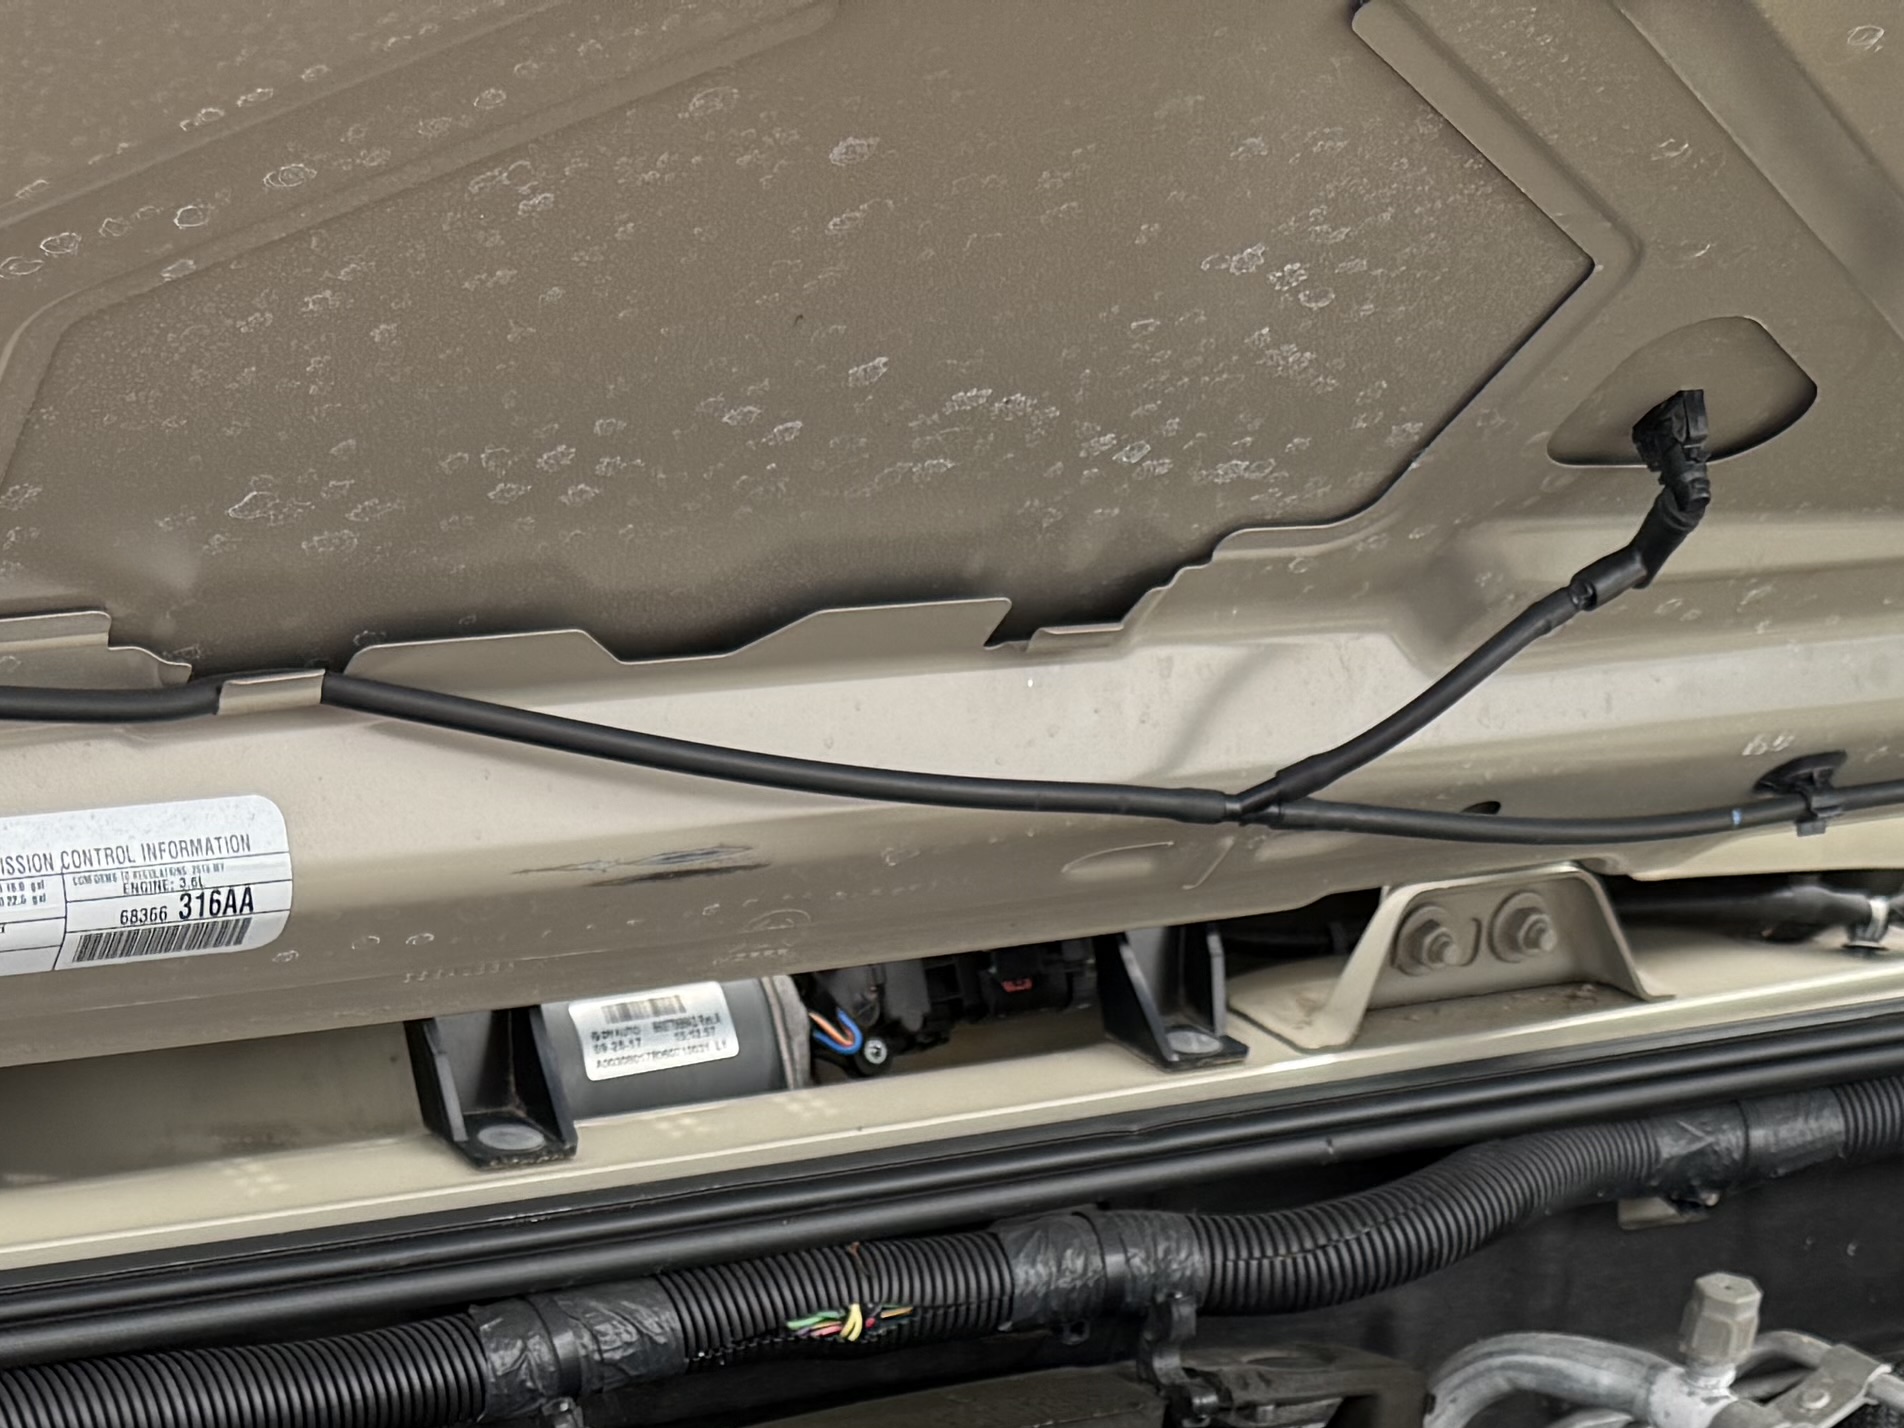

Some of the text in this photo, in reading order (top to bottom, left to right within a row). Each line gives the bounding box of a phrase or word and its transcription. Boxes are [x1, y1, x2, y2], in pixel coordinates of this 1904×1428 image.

[61, 845, 136, 870] CONTROL
[141, 833, 251, 861] INFORMATION
[119, 886, 254, 925] 68366 316AA
